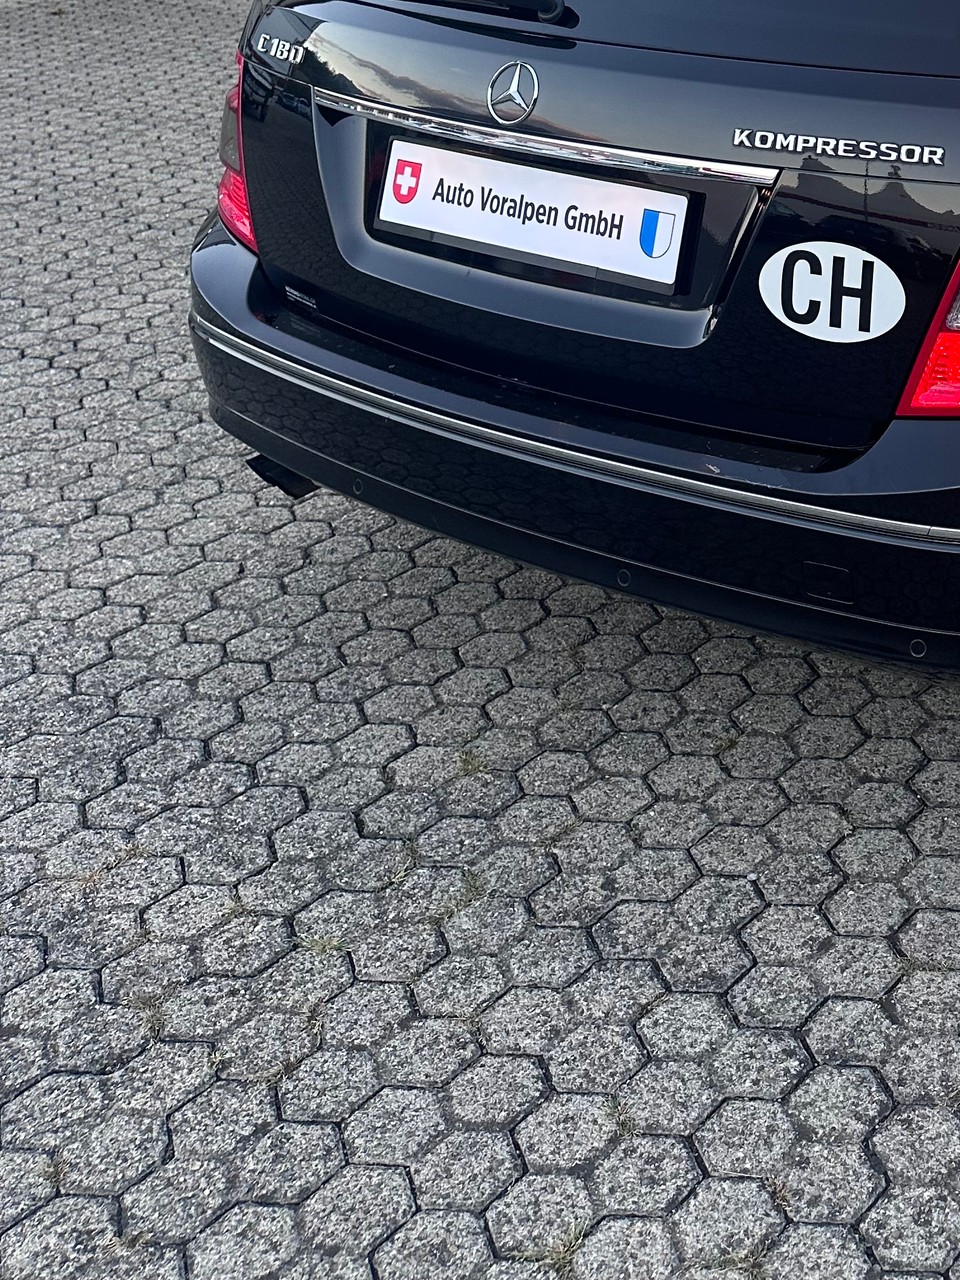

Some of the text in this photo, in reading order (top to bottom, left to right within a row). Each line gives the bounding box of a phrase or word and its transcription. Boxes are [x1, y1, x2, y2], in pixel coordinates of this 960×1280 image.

[733, 128, 945, 166] KOMPRESSOR
[432, 177, 625, 241] Auto Voralpen GmbH
[780, 249, 875, 333] CH
